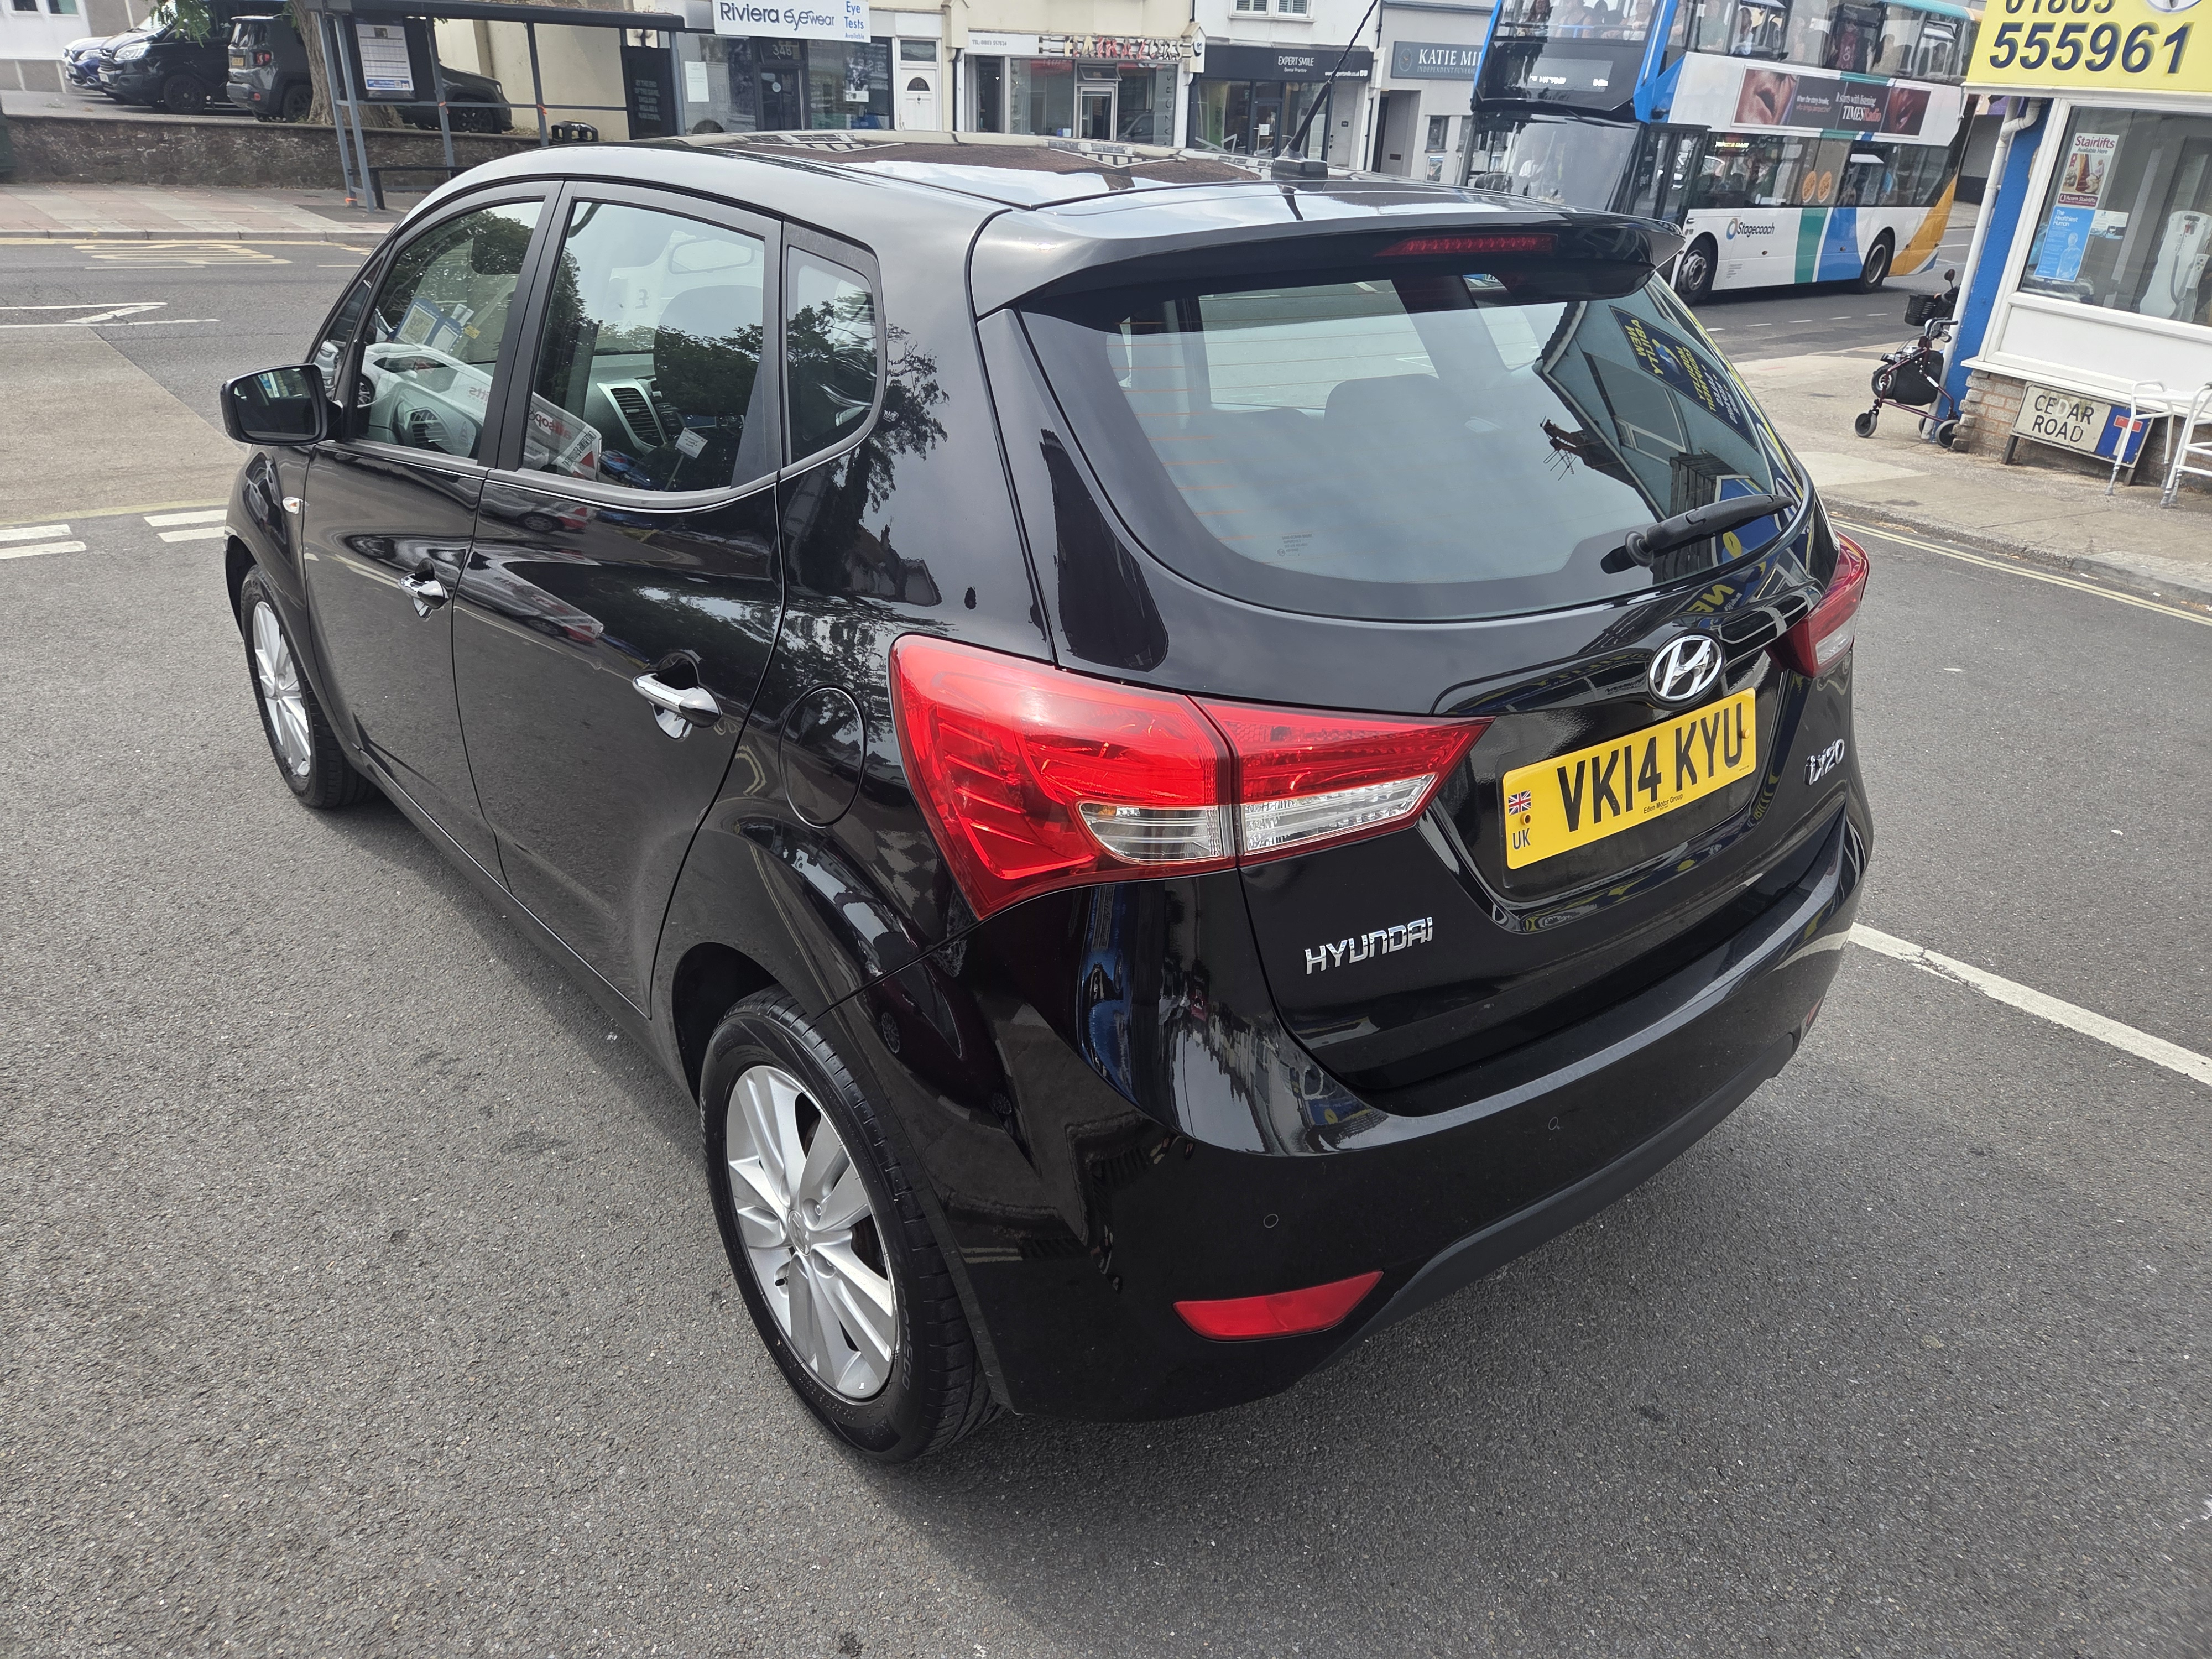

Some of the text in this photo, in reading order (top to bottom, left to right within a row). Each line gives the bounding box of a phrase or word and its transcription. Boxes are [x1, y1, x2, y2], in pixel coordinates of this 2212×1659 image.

[719, 2, 834, 31] Riviera eyewear
[846, 1, 861, 15] Eye
[844, 17, 864, 30] Tests
[772, 44, 792, 56] 348
[1418, 49, 1457, 65] KATIE
[1989, 21, 2195, 75] 555961
[1278, 56, 1314, 66] EXPERT SMILE
[1842, 105, 1882, 122] TIMES Radio
[2075, 135, 2116, 149] Stairlifts
[1737, 222, 1775, 238] Stagecoach
[2034, 394, 2095, 425] CEDAR
[2032, 415, 2084, 442] ROAD
[1556, 736, 1662, 833] VK14
[1675, 702, 1743, 792] KYU
[1644, 805, 1656, 814] Eden
[1656, 799, 1669, 809] Motor
[1670, 793, 1683, 804] Group
[1512, 827, 1531, 850] UK
[1305, 916, 1433, 975] HYUNDAI
